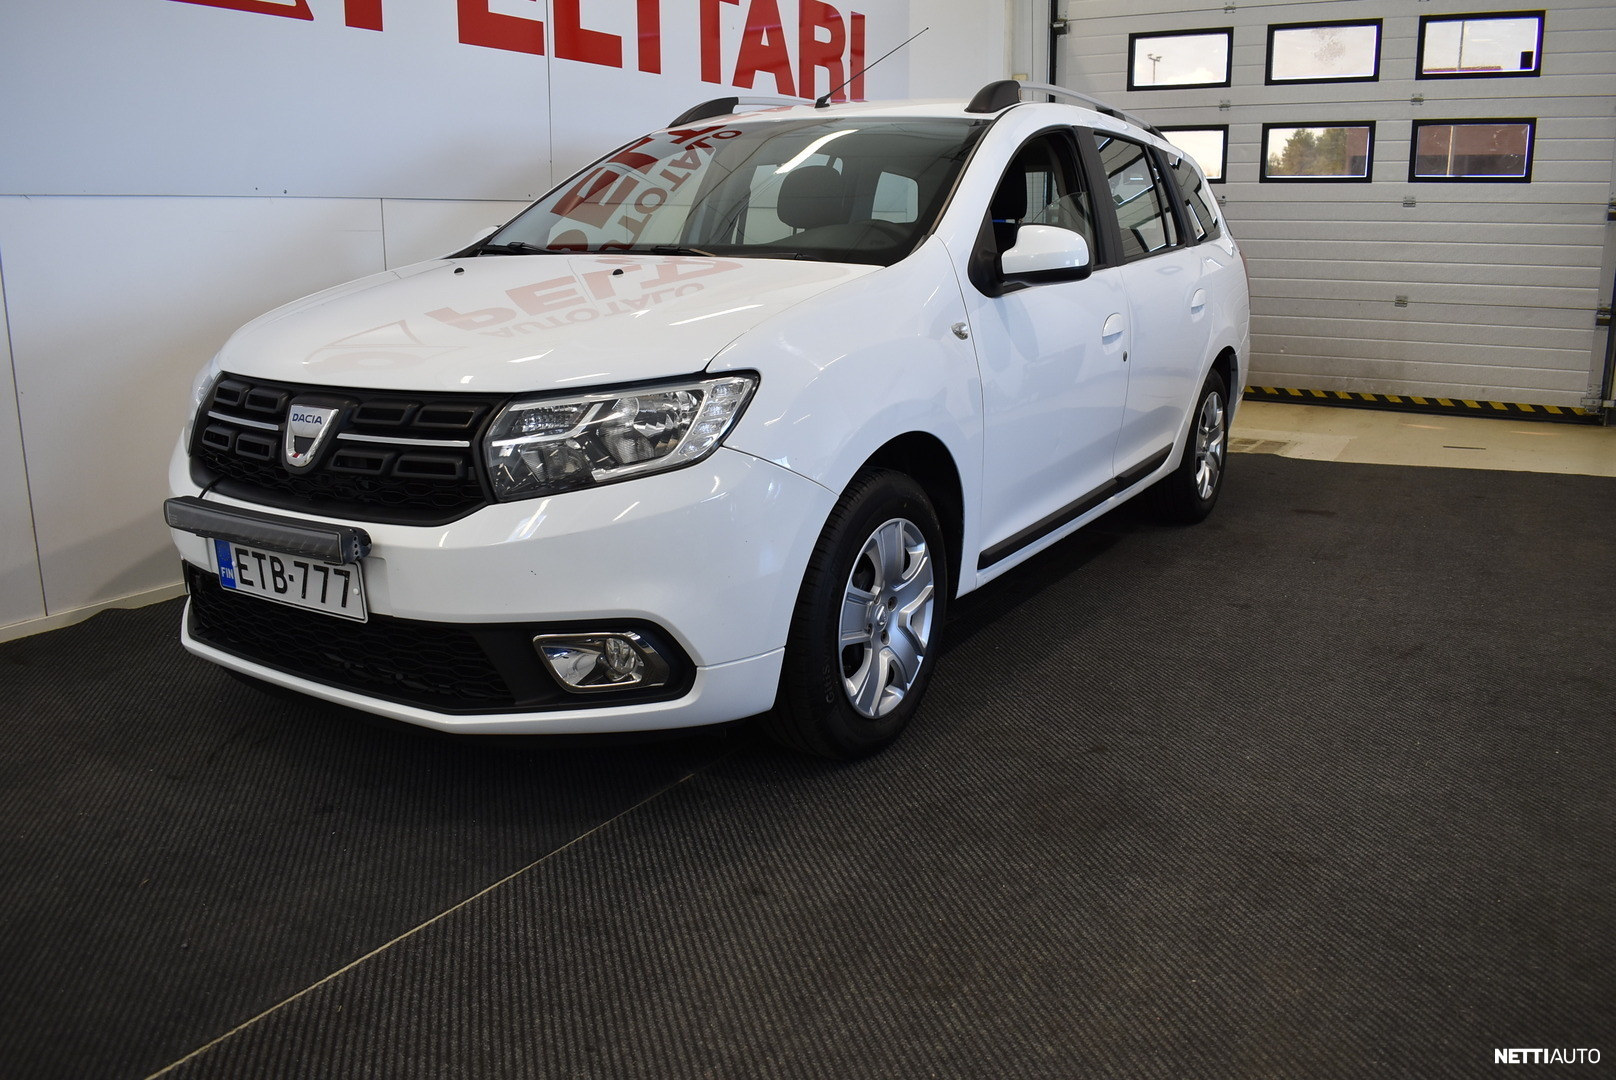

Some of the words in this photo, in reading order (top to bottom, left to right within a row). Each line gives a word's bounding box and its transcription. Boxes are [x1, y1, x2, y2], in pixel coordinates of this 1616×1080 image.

[292, 413, 322, 425] DACIA
[220, 566, 234, 580] FIN
[235, 548, 350, 608] ETB-777
